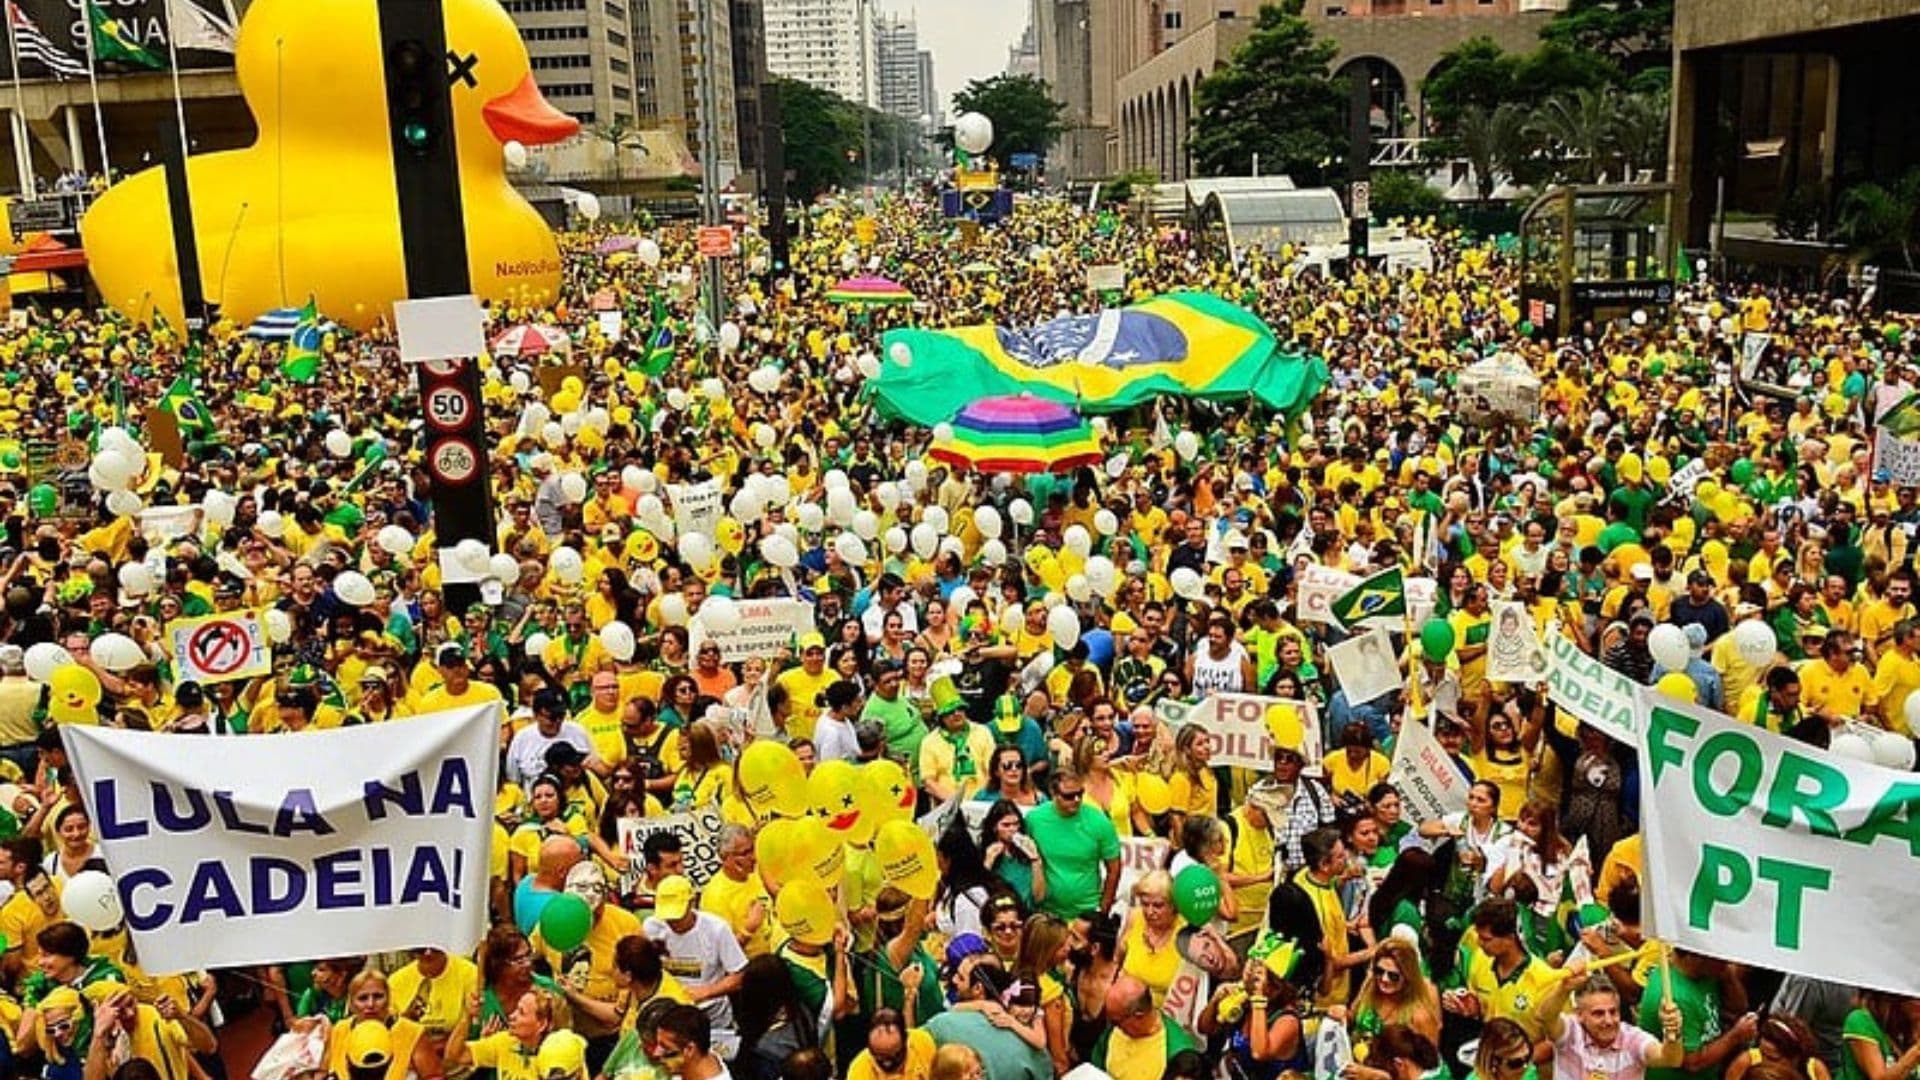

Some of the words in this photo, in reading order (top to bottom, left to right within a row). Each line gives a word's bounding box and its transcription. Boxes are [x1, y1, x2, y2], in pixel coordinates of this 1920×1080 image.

[434, 395, 464, 415] 50
[93, 778, 336, 841] LULA
[363, 757, 476, 821] NA
[1645, 706, 1920, 857] FORA
[117, 845, 464, 931] CADEIA!
[1688, 843, 1832, 950] PT
